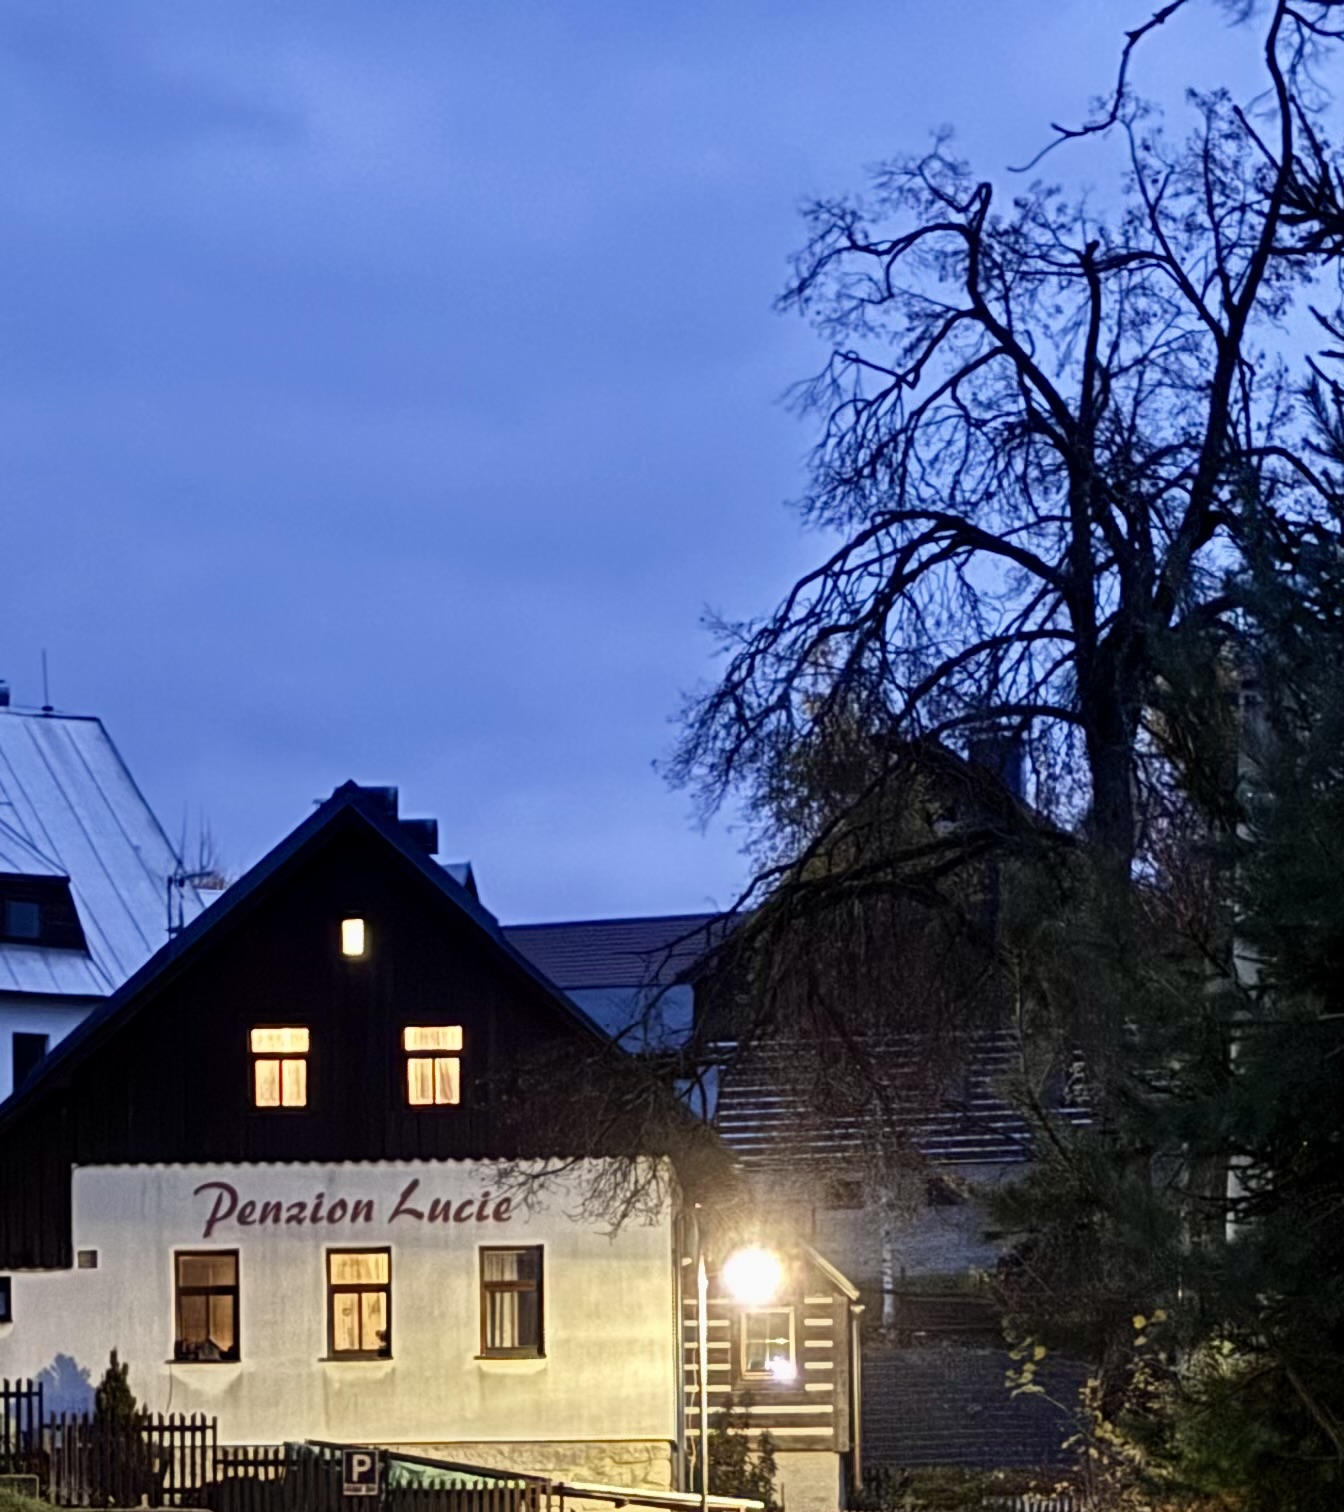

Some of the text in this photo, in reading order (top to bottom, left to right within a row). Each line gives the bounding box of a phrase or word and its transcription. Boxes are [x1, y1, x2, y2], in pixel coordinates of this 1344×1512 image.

[193, 1178, 513, 1239] Penzion Lucie
[352, 1454, 371, 1482] P
